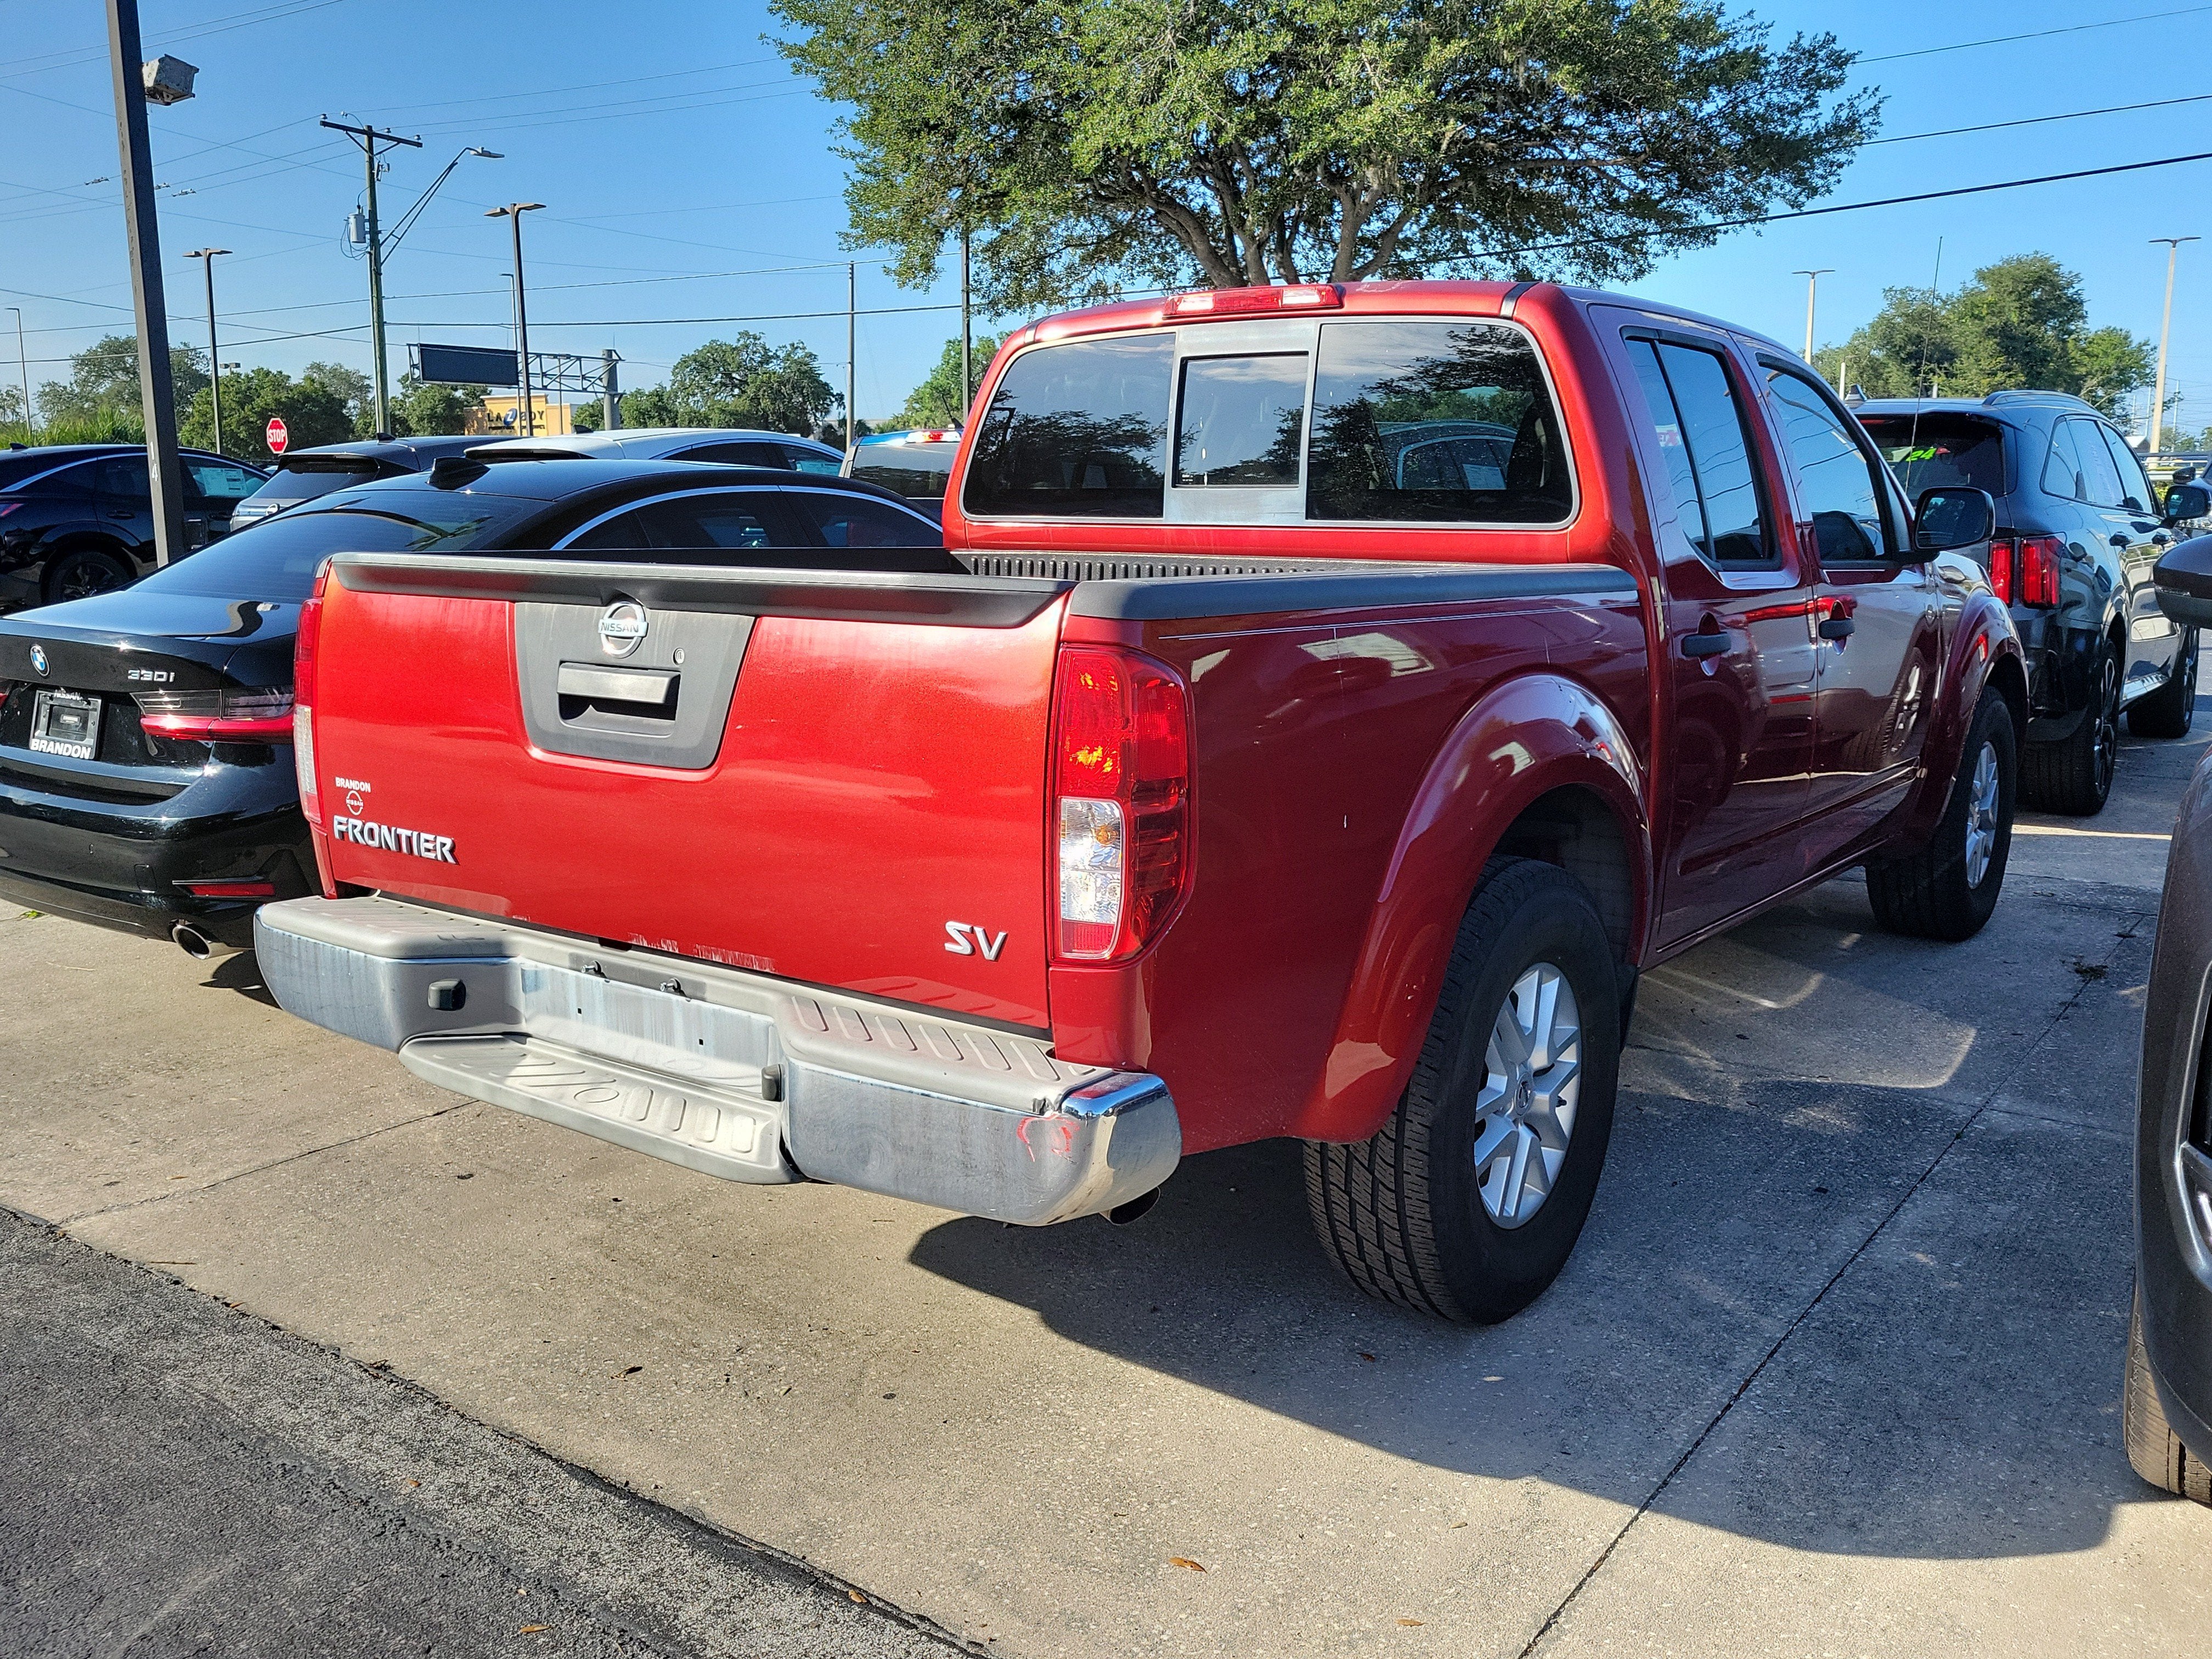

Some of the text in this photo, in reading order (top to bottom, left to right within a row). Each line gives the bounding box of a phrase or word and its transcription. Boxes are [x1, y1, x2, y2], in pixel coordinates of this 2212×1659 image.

[487, 413, 503, 422] LA
[269, 429, 285, 442] STOP
[601, 622, 639, 633] NISSAN
[128, 670, 175, 682] 330i
[30, 738, 92, 760] BRANDON
[335, 777, 371, 793] BRANDON
[346, 798, 364, 807] NISSAN
[334, 815, 459, 865] FRONTIER
[944, 921, 1008, 961] SV
